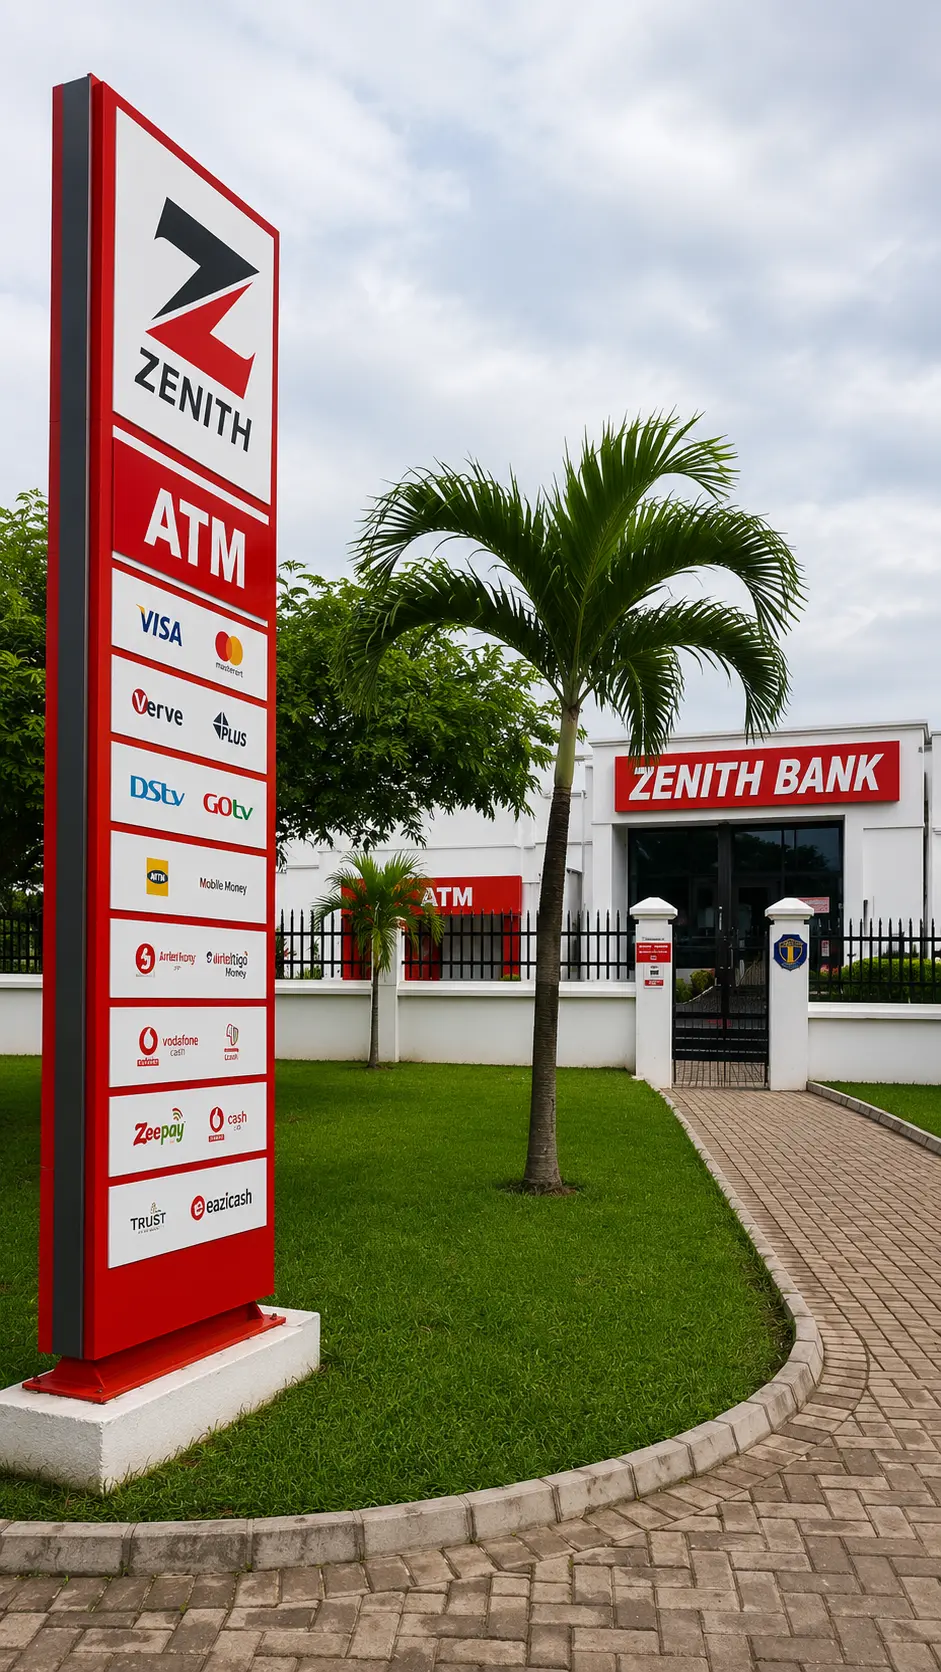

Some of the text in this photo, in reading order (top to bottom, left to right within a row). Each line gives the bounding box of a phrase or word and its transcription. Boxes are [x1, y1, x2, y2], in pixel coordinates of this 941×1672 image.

[134, 346, 252, 452] ZENITH
[144, 487, 246, 589] ATM
[136, 604, 183, 647] VISA
[132, 688, 183, 726] Verve
[221, 726, 247, 747] PLUS
[629, 753, 884, 801] ZENITH BANK
[130, 775, 185, 807] DStv
[203, 792, 253, 821] GOtv
[199, 877, 247, 895] Mobile Money
[420, 886, 473, 907] ATM
[162, 1034, 199, 1046] vodafone
[227, 1111, 247, 1125] cash
[133, 1122, 185, 1146] Zeepay
[206, 1188, 252, 1213] eazicash
[130, 1212, 166, 1231] TRUST
